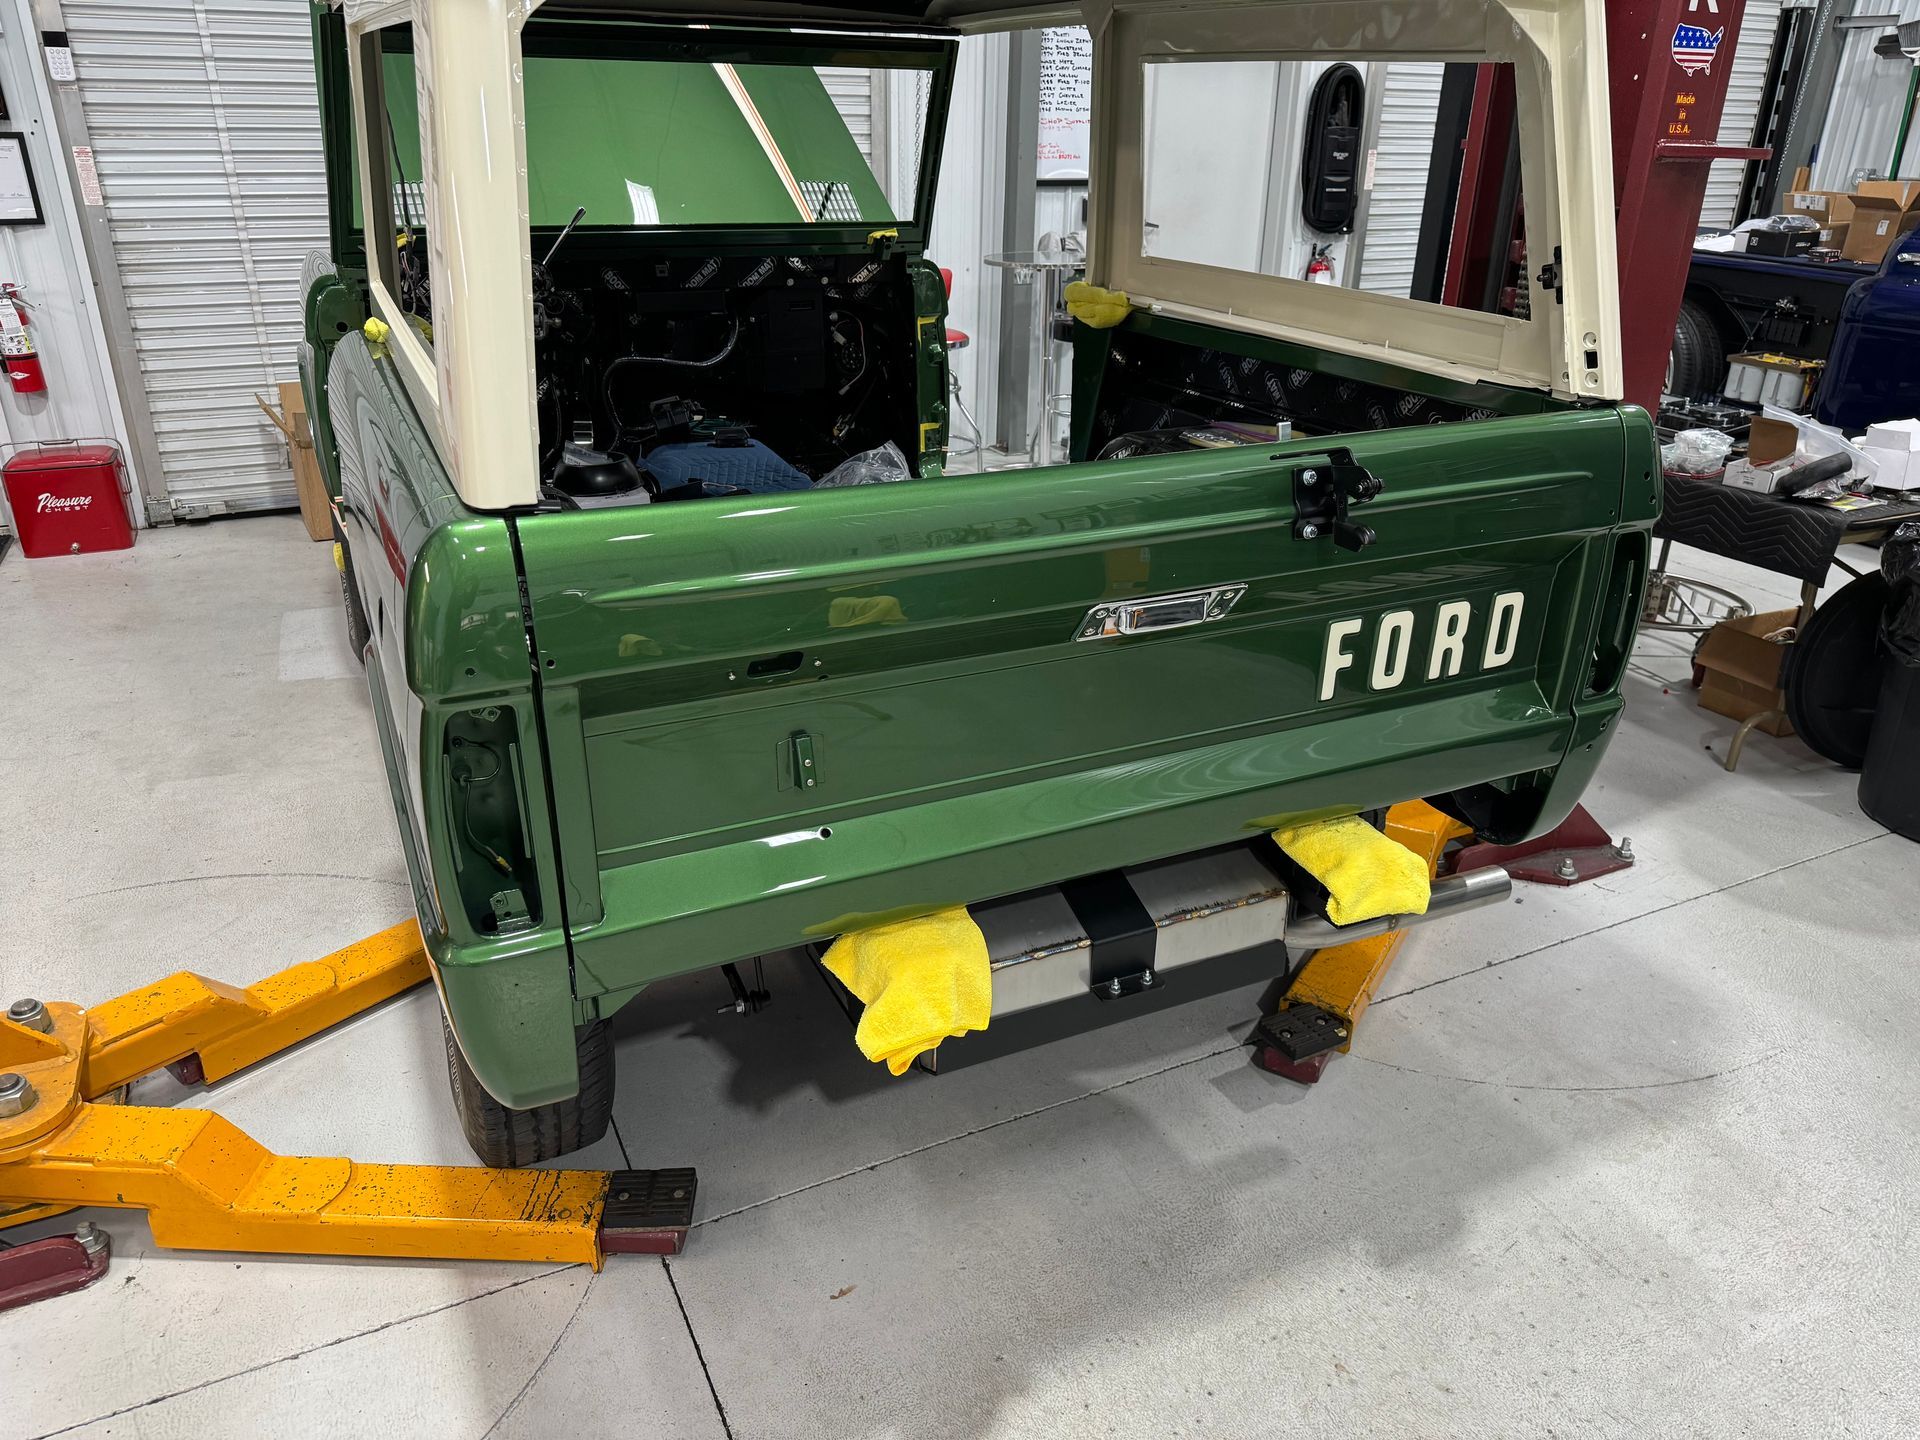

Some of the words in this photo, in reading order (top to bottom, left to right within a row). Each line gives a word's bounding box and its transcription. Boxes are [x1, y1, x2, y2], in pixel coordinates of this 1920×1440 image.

[1676, 95, 1696, 104] Made
[1679, 110, 1686, 120] in
[1669, 125, 1690, 134] U.S.A.
[37, 493, 93, 513] Pleasure
[45, 505, 89, 513] CHEST
[1320, 591, 1525, 701] FORD
